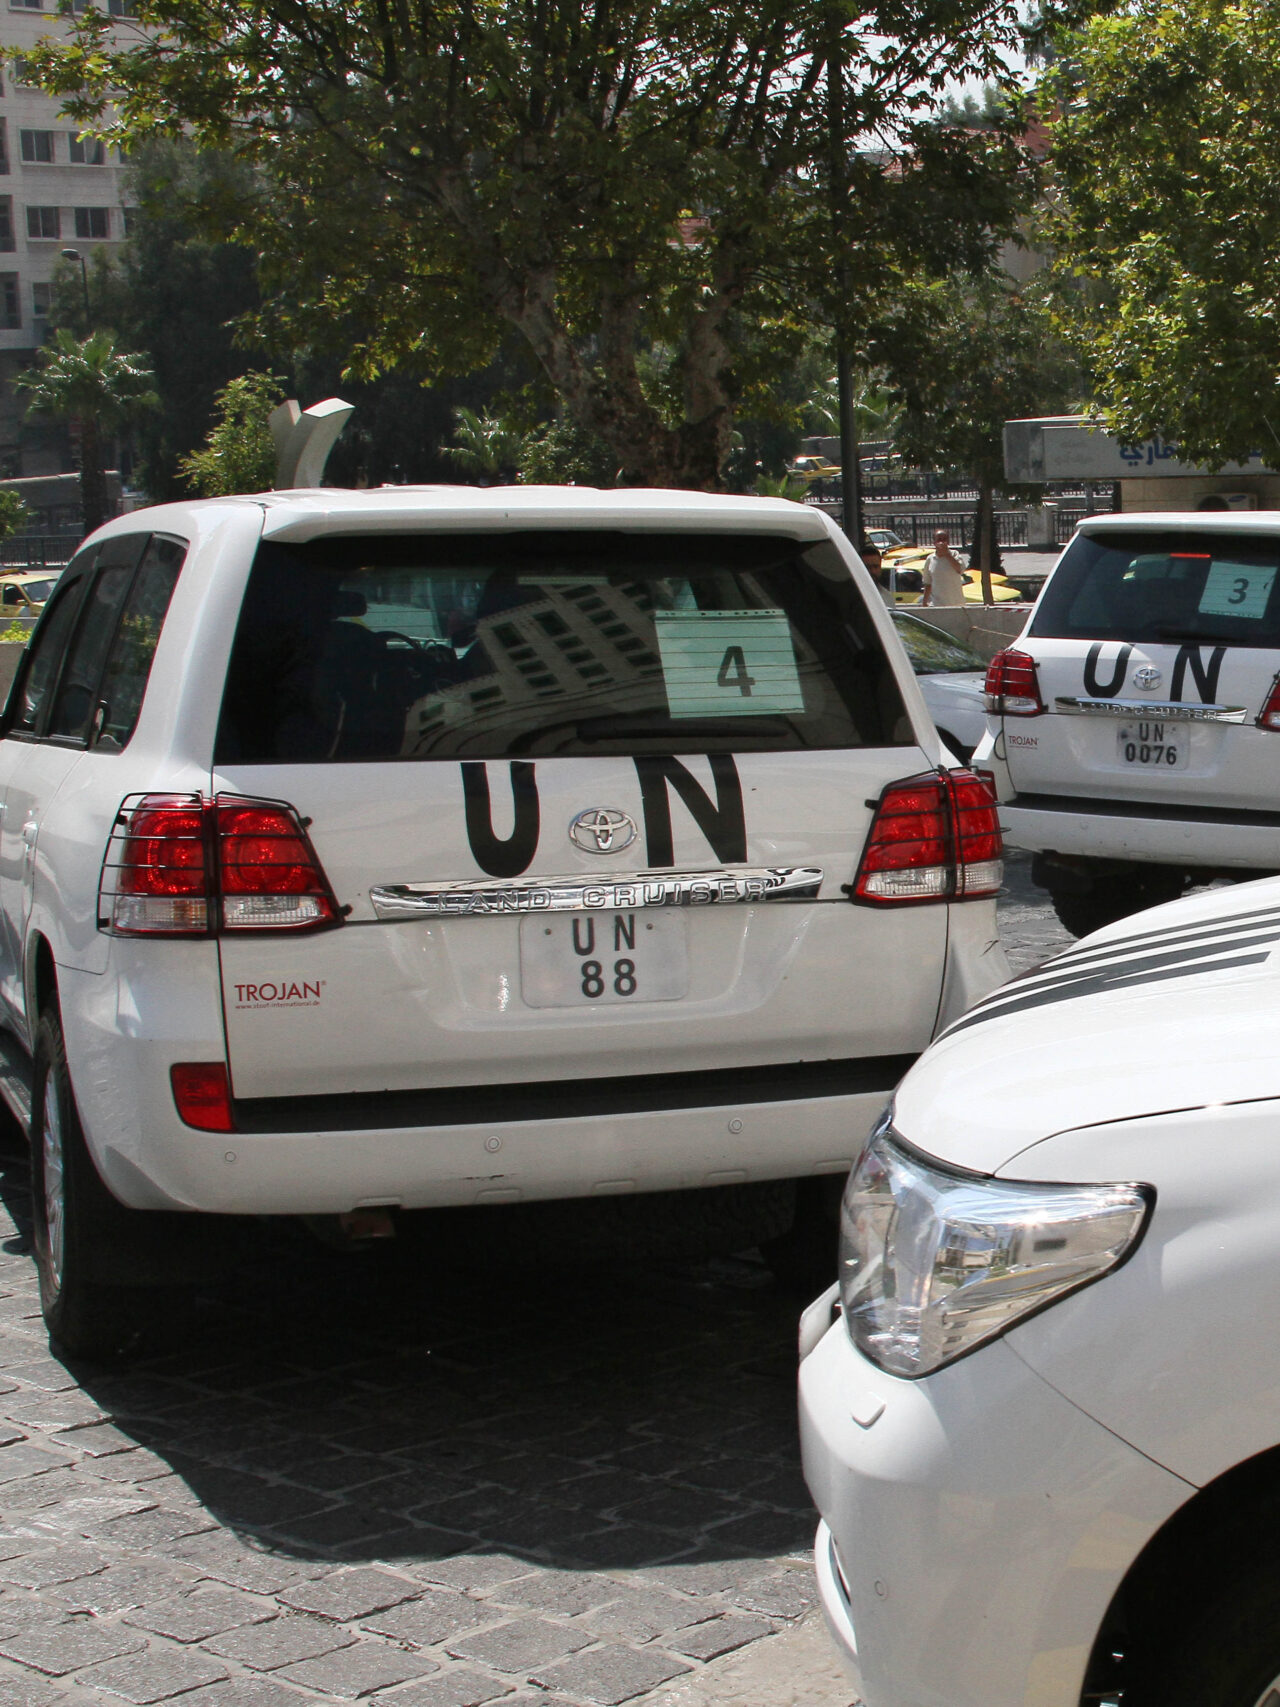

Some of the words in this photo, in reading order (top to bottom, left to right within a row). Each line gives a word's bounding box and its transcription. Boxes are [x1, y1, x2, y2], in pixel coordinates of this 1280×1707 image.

[1227, 578, 1249, 604] 3
[717, 645, 756, 697] 4
[1008, 735, 1038, 745] TROJAN
[1139, 723, 1164, 742] UN
[1125, 743, 1177, 765] 0076
[437, 887, 552, 914] LAND
[582, 879, 768, 909] CRUISER
[572, 914, 636, 956] UN
[581, 958, 638, 998] 88
